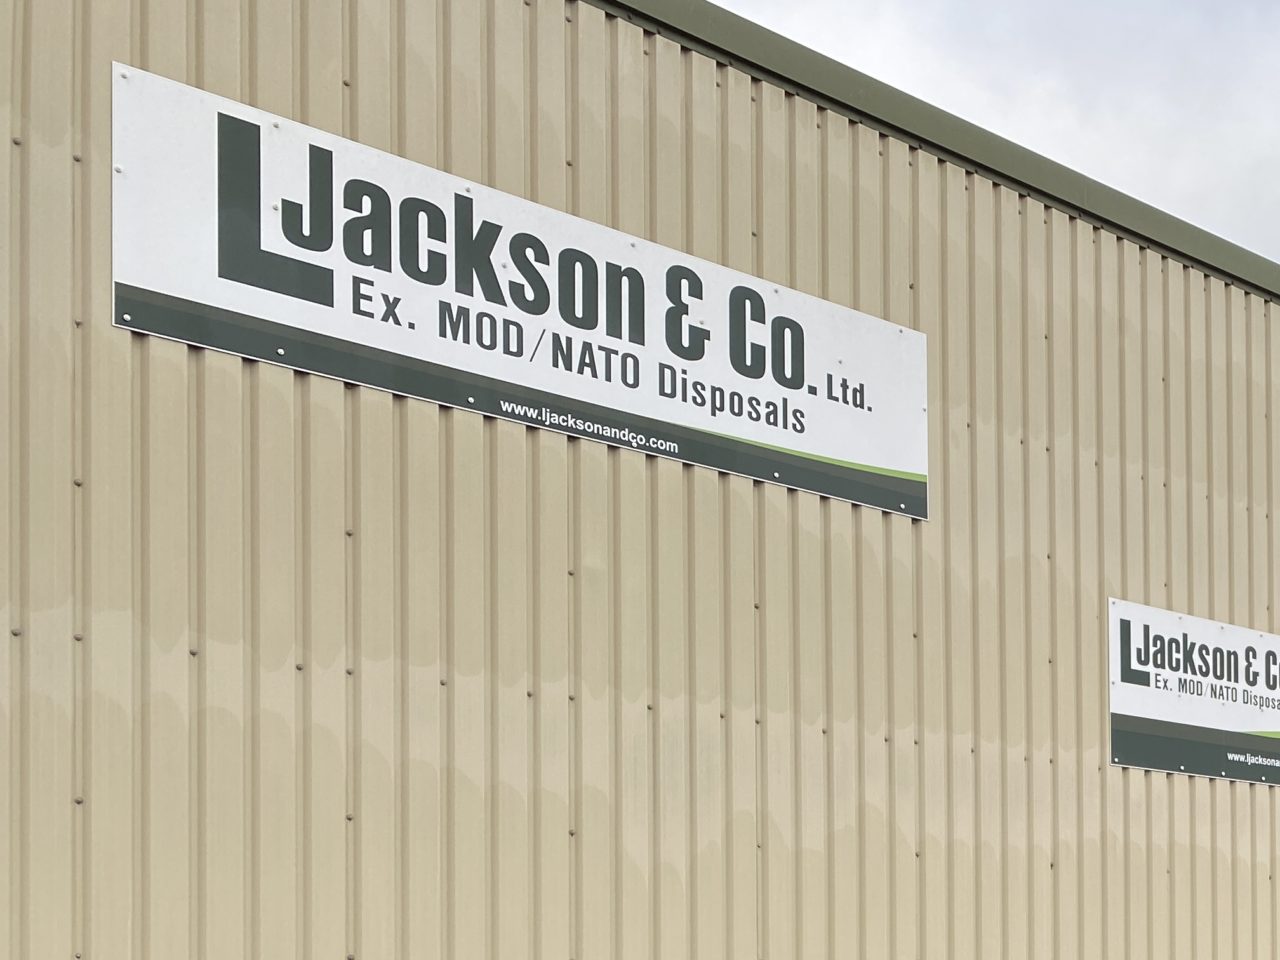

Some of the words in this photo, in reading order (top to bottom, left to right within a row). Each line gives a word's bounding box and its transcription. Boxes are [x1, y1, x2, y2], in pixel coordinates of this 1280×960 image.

[351, 275, 416, 330] Ex.
[658, 362, 806, 434] Disposals
[664, 263, 711, 362] &
[728, 285, 818, 396] Co.
[826, 373, 873, 412] Ltd.
[500, 400, 679, 454] www.ljacksonandco.com
[1155, 673, 1172, 691] Ex.
[1245, 645, 1259, 686] &
